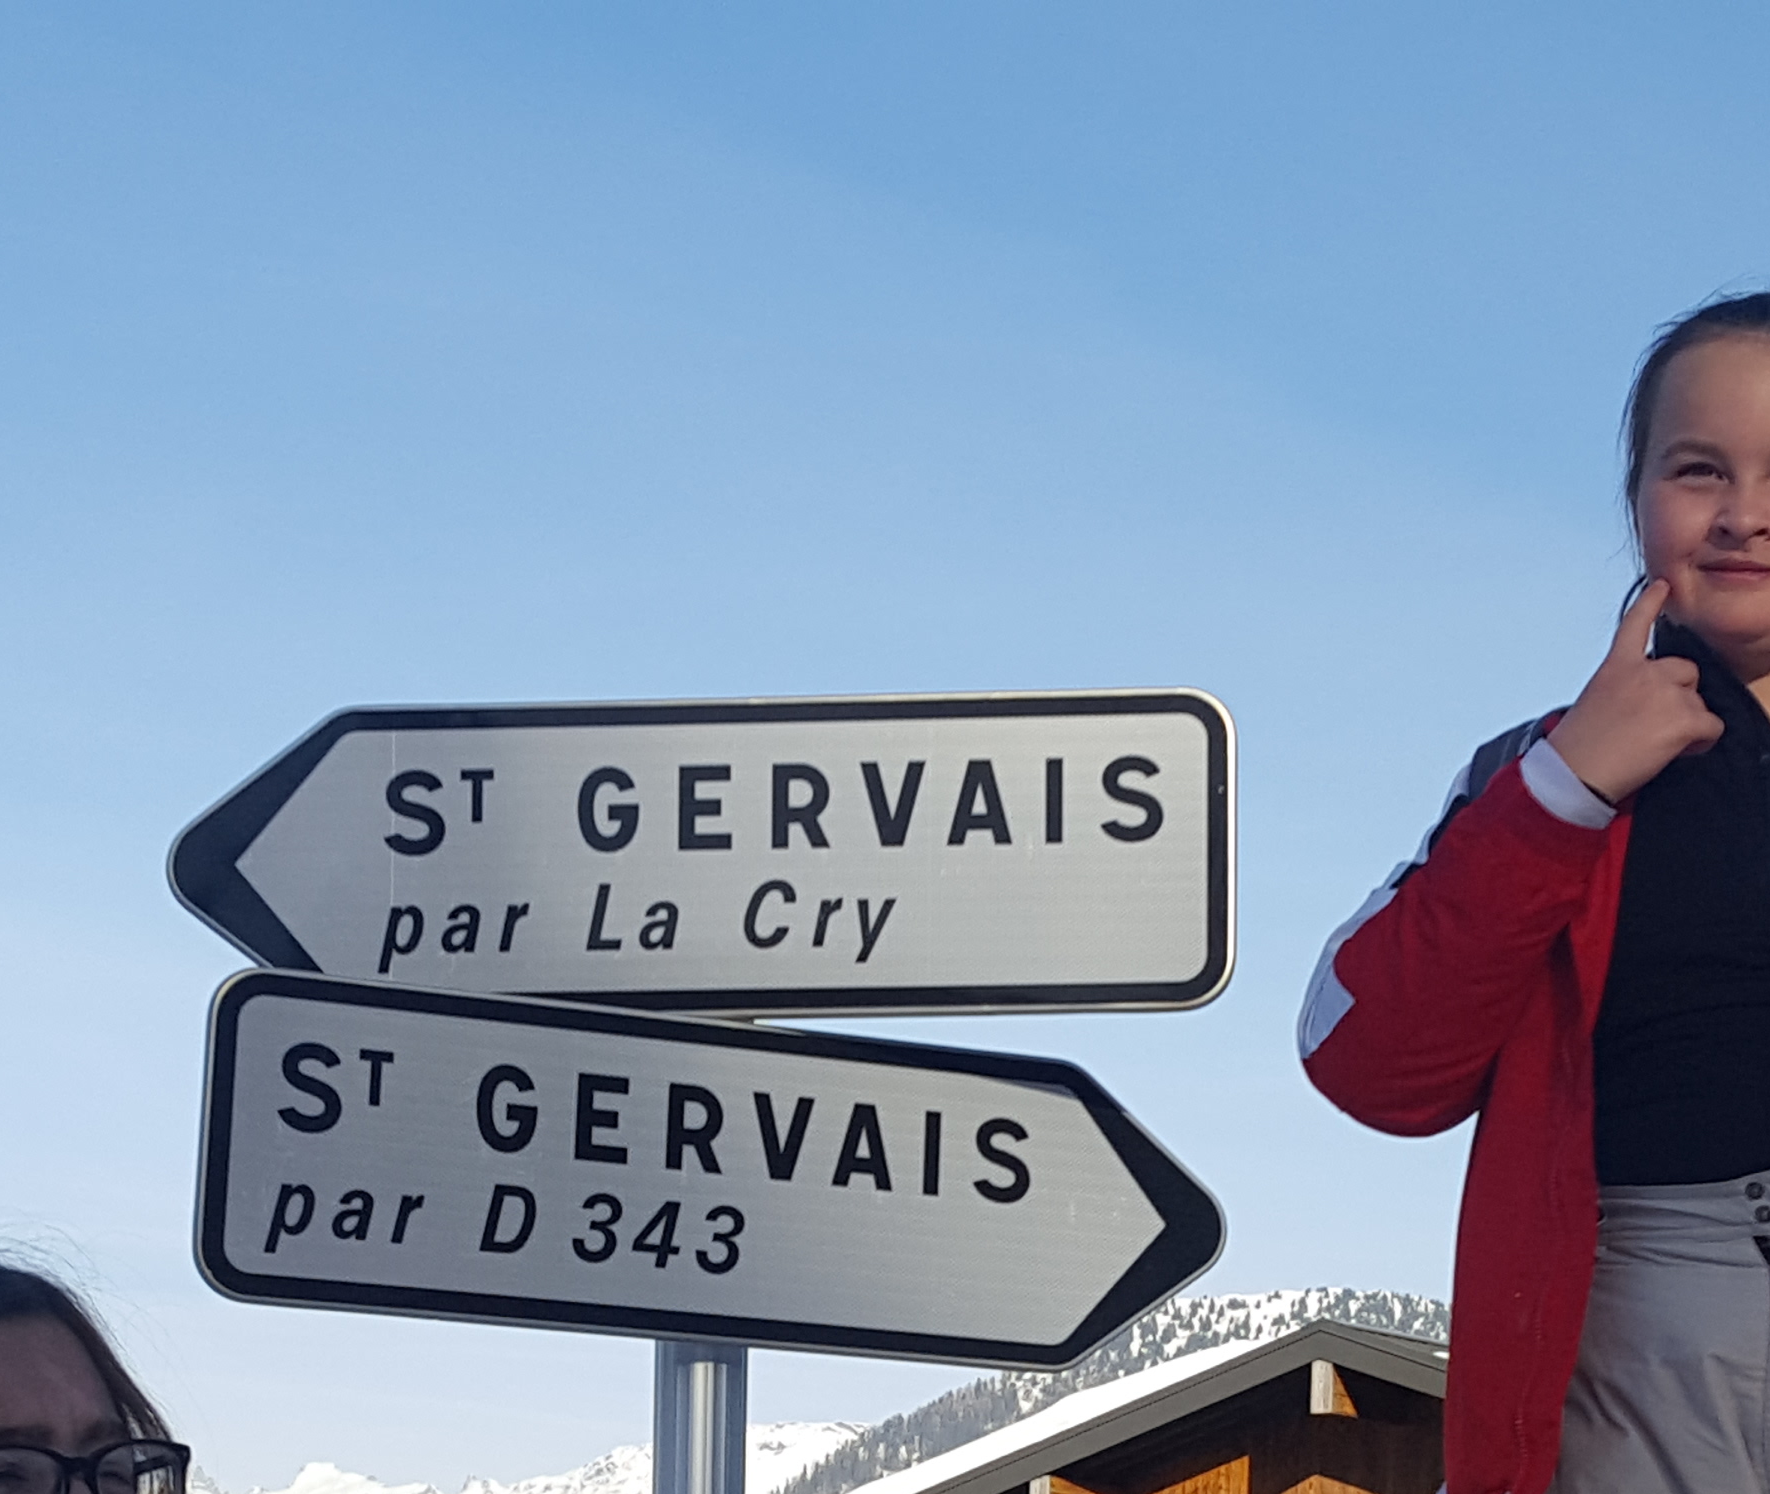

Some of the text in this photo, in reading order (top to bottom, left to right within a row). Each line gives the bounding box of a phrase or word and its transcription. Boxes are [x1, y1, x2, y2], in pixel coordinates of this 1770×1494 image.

[382, 755, 1165, 858] ST GERVAIS
[376, 878, 898, 972] par La Cry
[274, 1040, 1032, 1205] ST GERVAIS
[261, 1180, 747, 1277] par D 343
